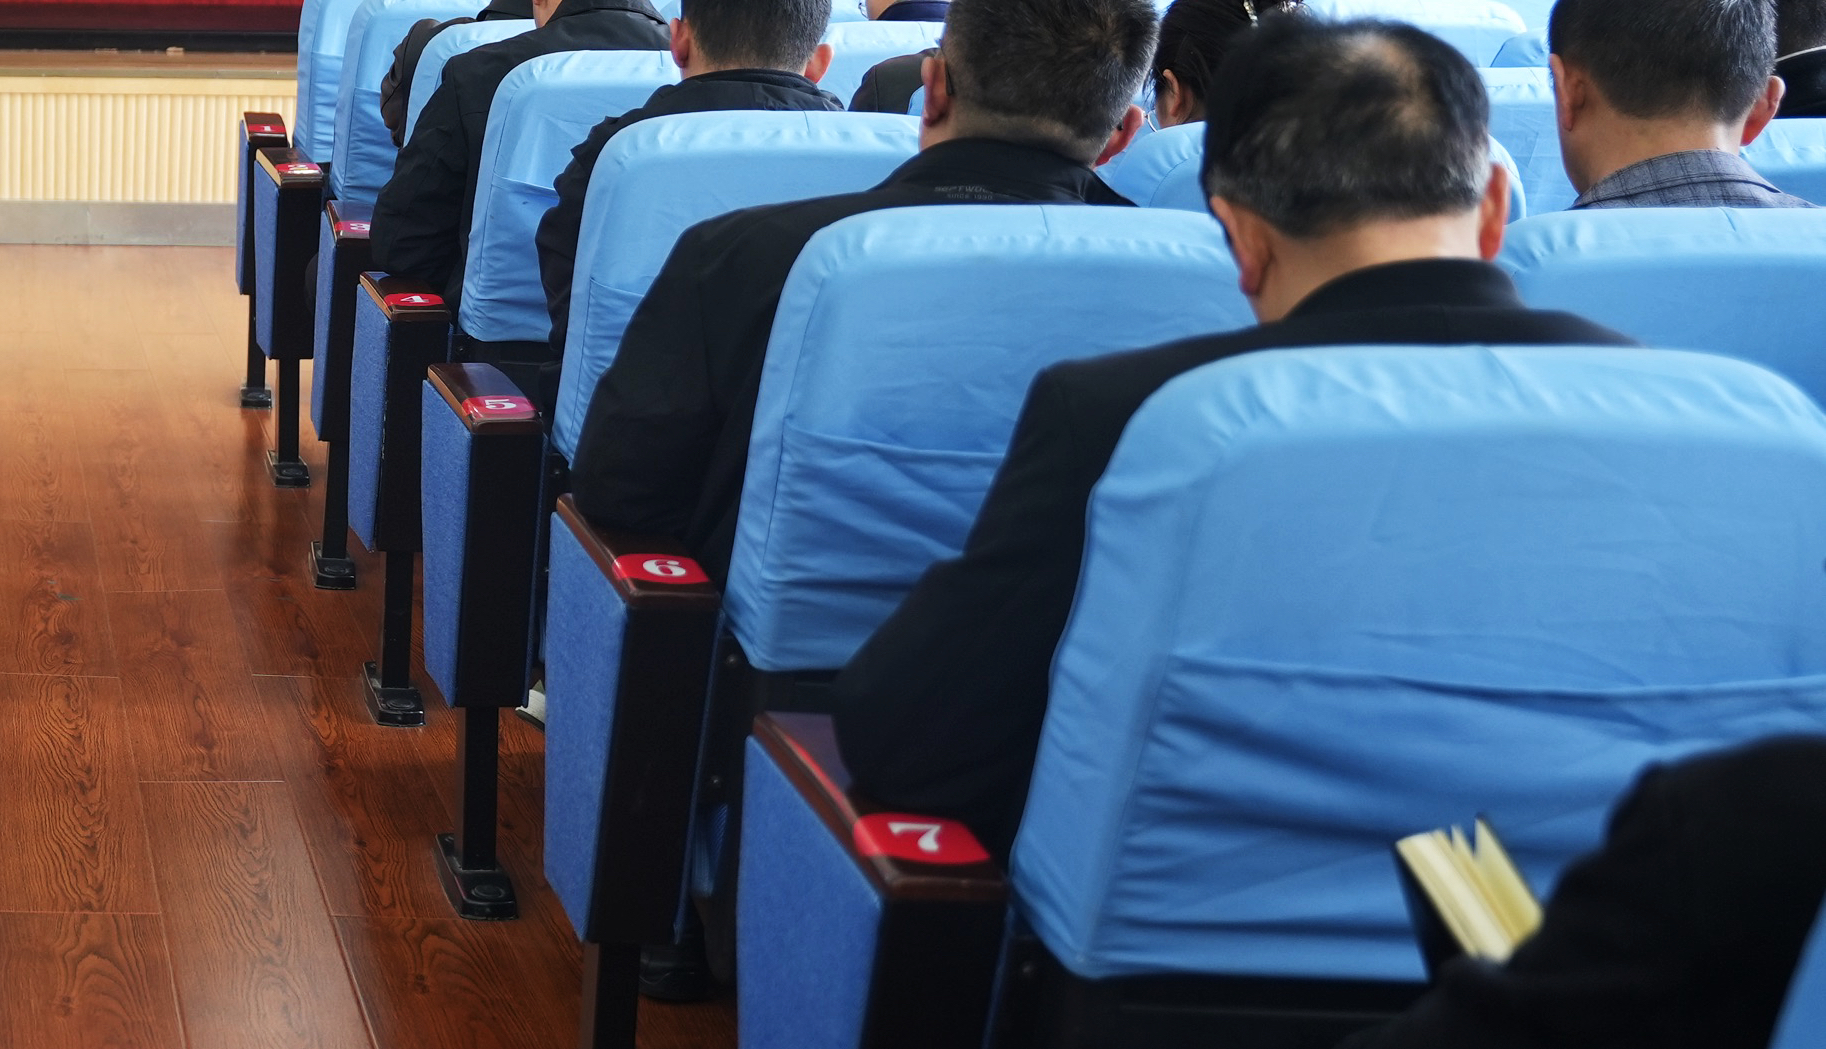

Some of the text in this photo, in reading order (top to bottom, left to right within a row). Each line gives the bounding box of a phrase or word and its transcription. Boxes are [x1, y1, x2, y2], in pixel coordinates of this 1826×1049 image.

[349, 223, 371, 231] 3
[400, 295, 430, 303] 4
[484, 398, 517, 410] 5
[642, 559, 687, 577] 6
[887, 821, 942, 853] 7
